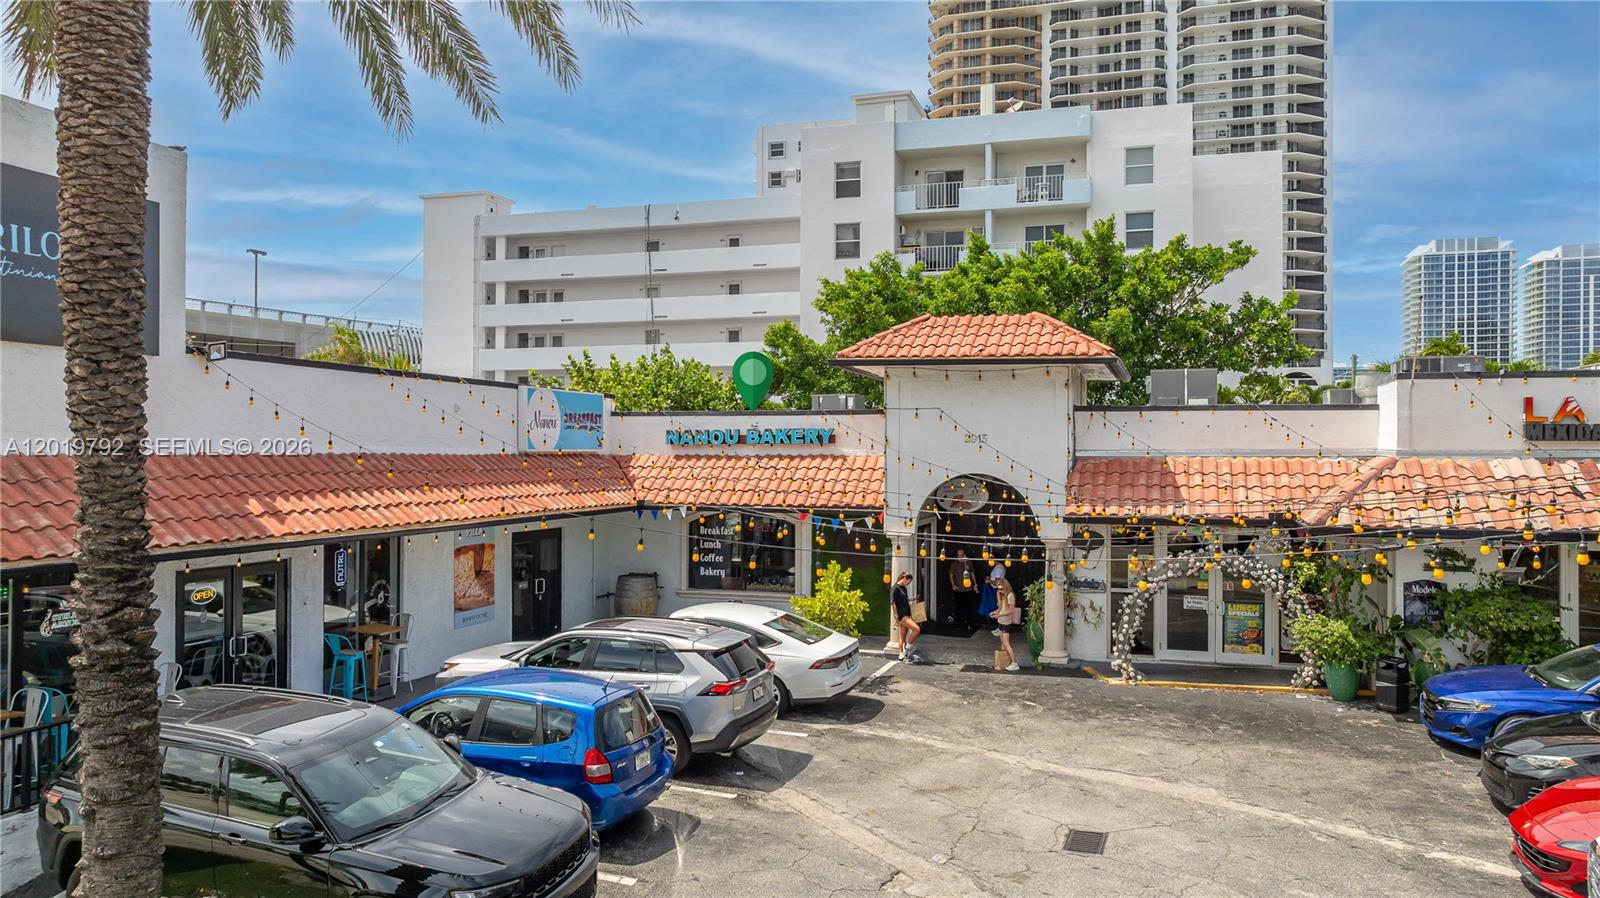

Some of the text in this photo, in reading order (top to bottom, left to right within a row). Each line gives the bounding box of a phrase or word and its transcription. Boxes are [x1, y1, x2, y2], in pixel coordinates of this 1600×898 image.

[1523, 396, 1586, 423] LA
[666, 428, 835, 445] NANOU BAKERY
[700, 526, 735, 535] Breakfast
[700, 540, 721, 549] Lunch
[700, 554, 723, 562] Coffee
[700, 567, 725, 578] Bakery
[193, 590, 213, 600] OPEN
